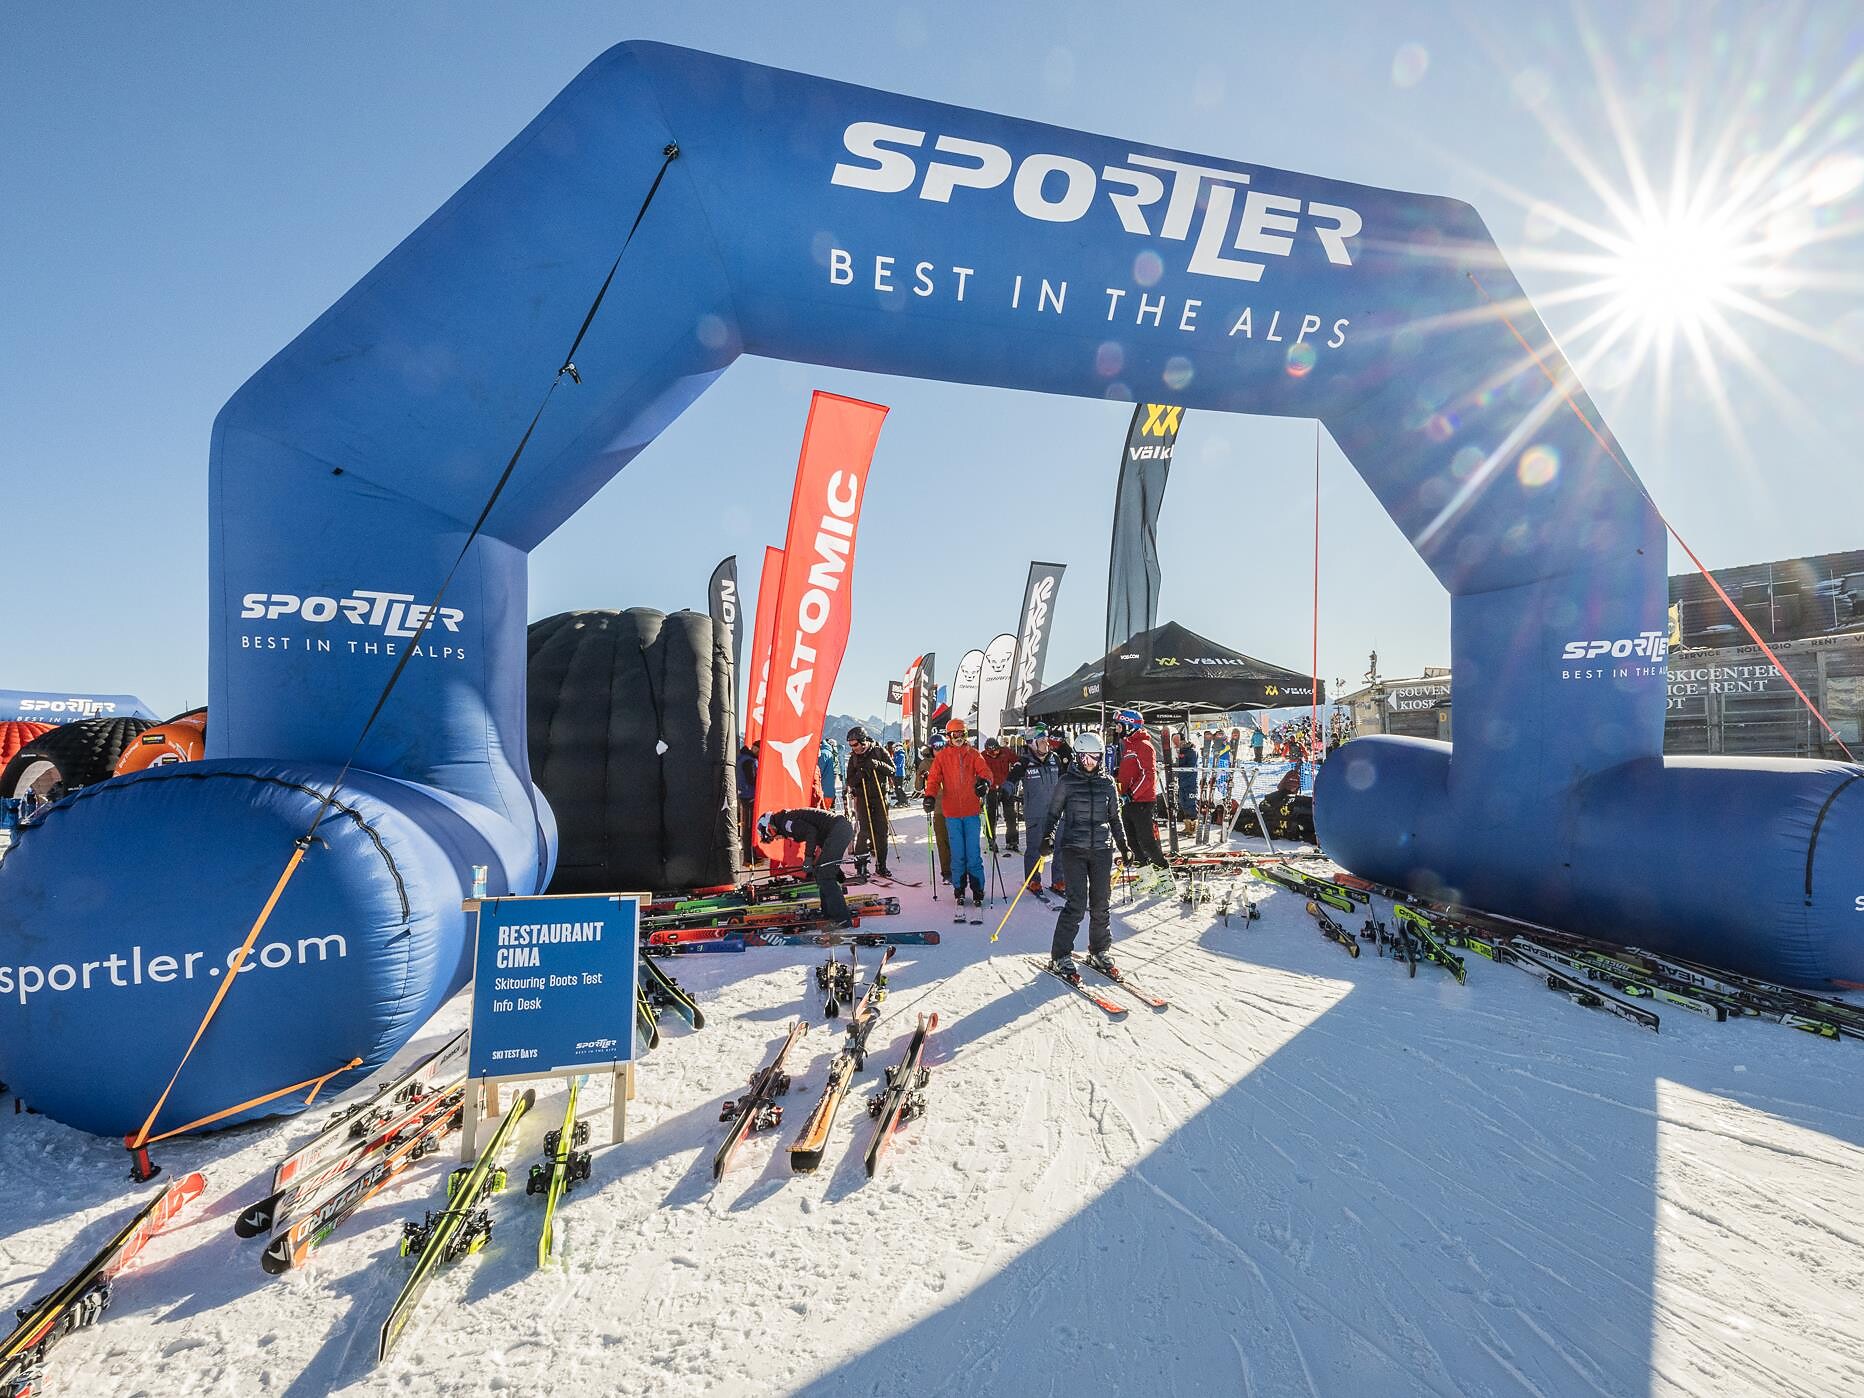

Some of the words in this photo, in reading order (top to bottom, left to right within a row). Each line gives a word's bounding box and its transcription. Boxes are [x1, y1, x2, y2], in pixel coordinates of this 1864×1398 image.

[830, 121, 1363, 282] SPORTLER
[830, 247, 974, 301] BEST
[1011, 275, 1068, 314] IN
[1105, 288, 1203, 332] THE
[1229, 306, 1350, 349] ALPS
[785, 469, 858, 718] ATOMIC
[240, 589, 465, 638] SPORTLER
[241, 635, 290, 650] BEST
[306, 638, 330, 652] IN
[348, 641, 396, 656] THE
[411, 645, 465, 659] ALPS
[1678, 650, 1721, 660] SERVICE
[1736, 642, 1792, 654] NOLGIO
[1811, 638, 1837, 646] RENT
[1562, 669, 1603, 679] BEST
[1613, 668, 1628, 678] IN
[1635, 667, 1655, 677] THE
[1666, 665, 1783, 682] SKICENTER
[19, 698, 117, 717] SPORTLER
[1400, 699, 1437, 710] KIOSK
[498, 921, 604, 946] RESTAURANT
[496, 946, 540, 969] CIMA
[0, 933, 347, 1005] sportler.com
[494, 976, 546, 991] Skitouring
[549, 973, 578, 987] Boots
[582, 972, 603, 985] Test
[493, 999, 513, 1013] Info
[517, 997, 542, 1011] Desk
[492, 1051, 504, 1061] SKI
[504, 1050, 520, 1060] TEST
[520, 1048, 538, 1060] DAYS
[575, 1038, 616, 1049] SPORTLER
[297, 1164, 385, 1242] BLIZZARD
